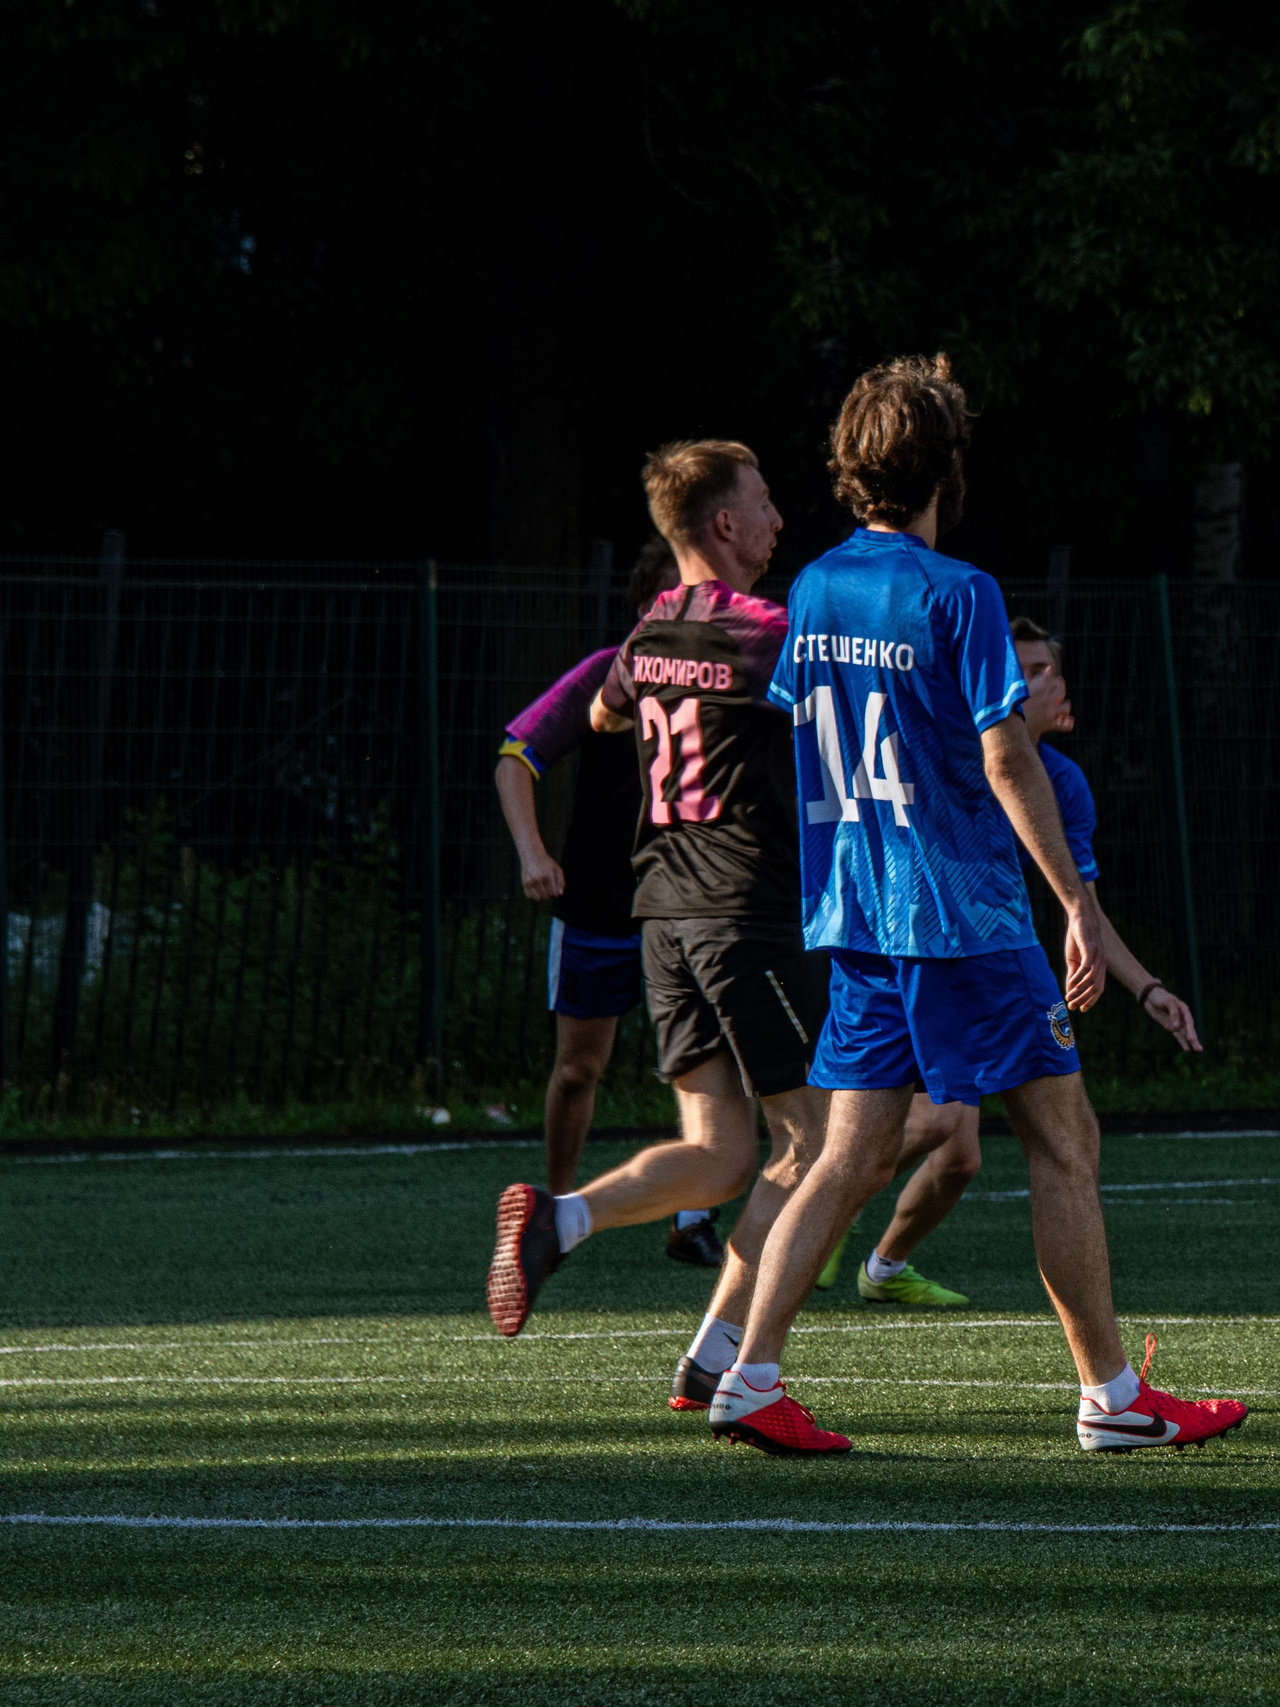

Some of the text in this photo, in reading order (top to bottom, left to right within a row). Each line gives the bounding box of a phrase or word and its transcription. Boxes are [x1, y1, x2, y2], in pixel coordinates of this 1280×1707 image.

[793, 634, 914, 671] СТЕШЕНКО
[639, 695, 722, 826] 21
[793, 686, 915, 829] 14
